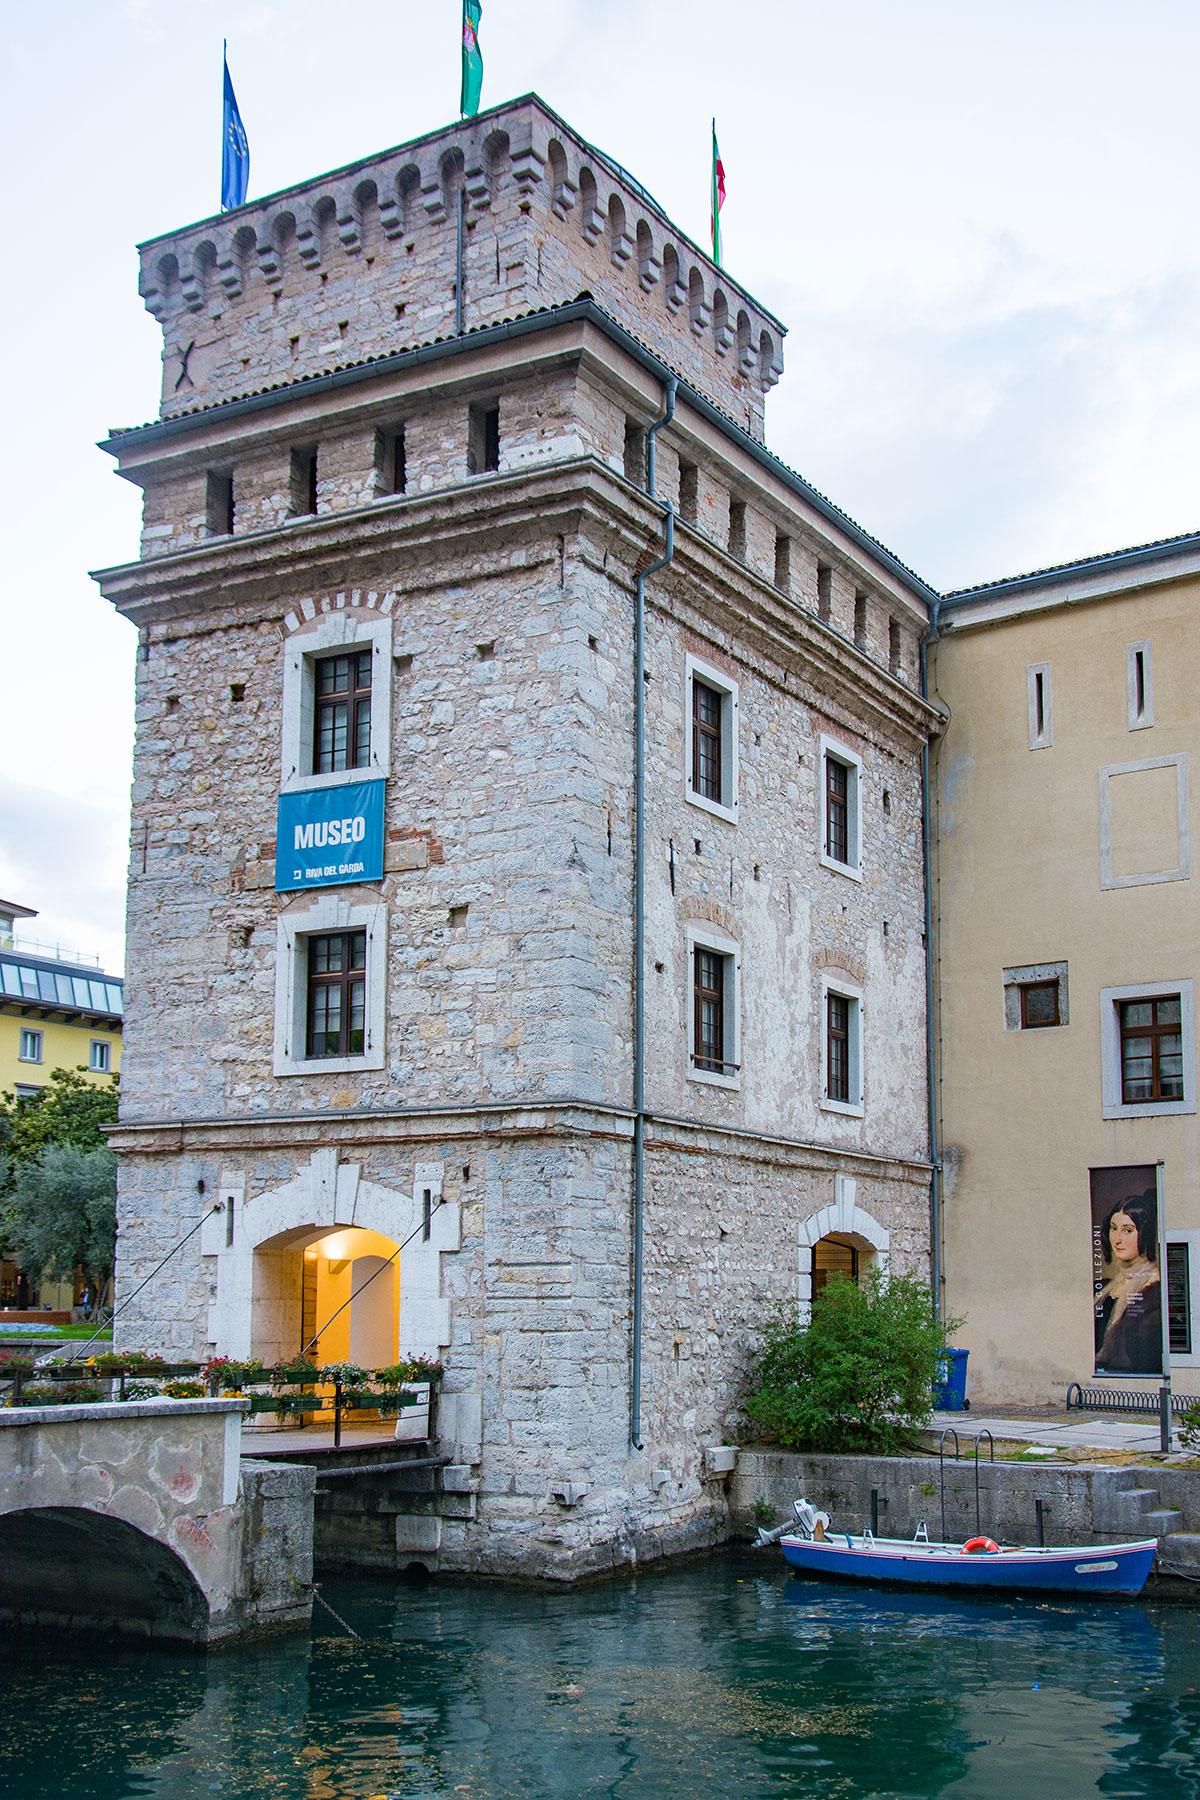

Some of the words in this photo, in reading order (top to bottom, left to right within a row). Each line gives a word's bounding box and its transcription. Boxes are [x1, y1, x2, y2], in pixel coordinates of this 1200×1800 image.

[294, 816, 365, 850] MUSEO
[305, 867, 322, 879] RIVA
[324, 865, 337, 876] DEL
[338, 862, 364, 874] GARDA
[1093, 1225, 1103, 1298] COLLEZIONI
[1095, 1304, 1104, 1318] LE
